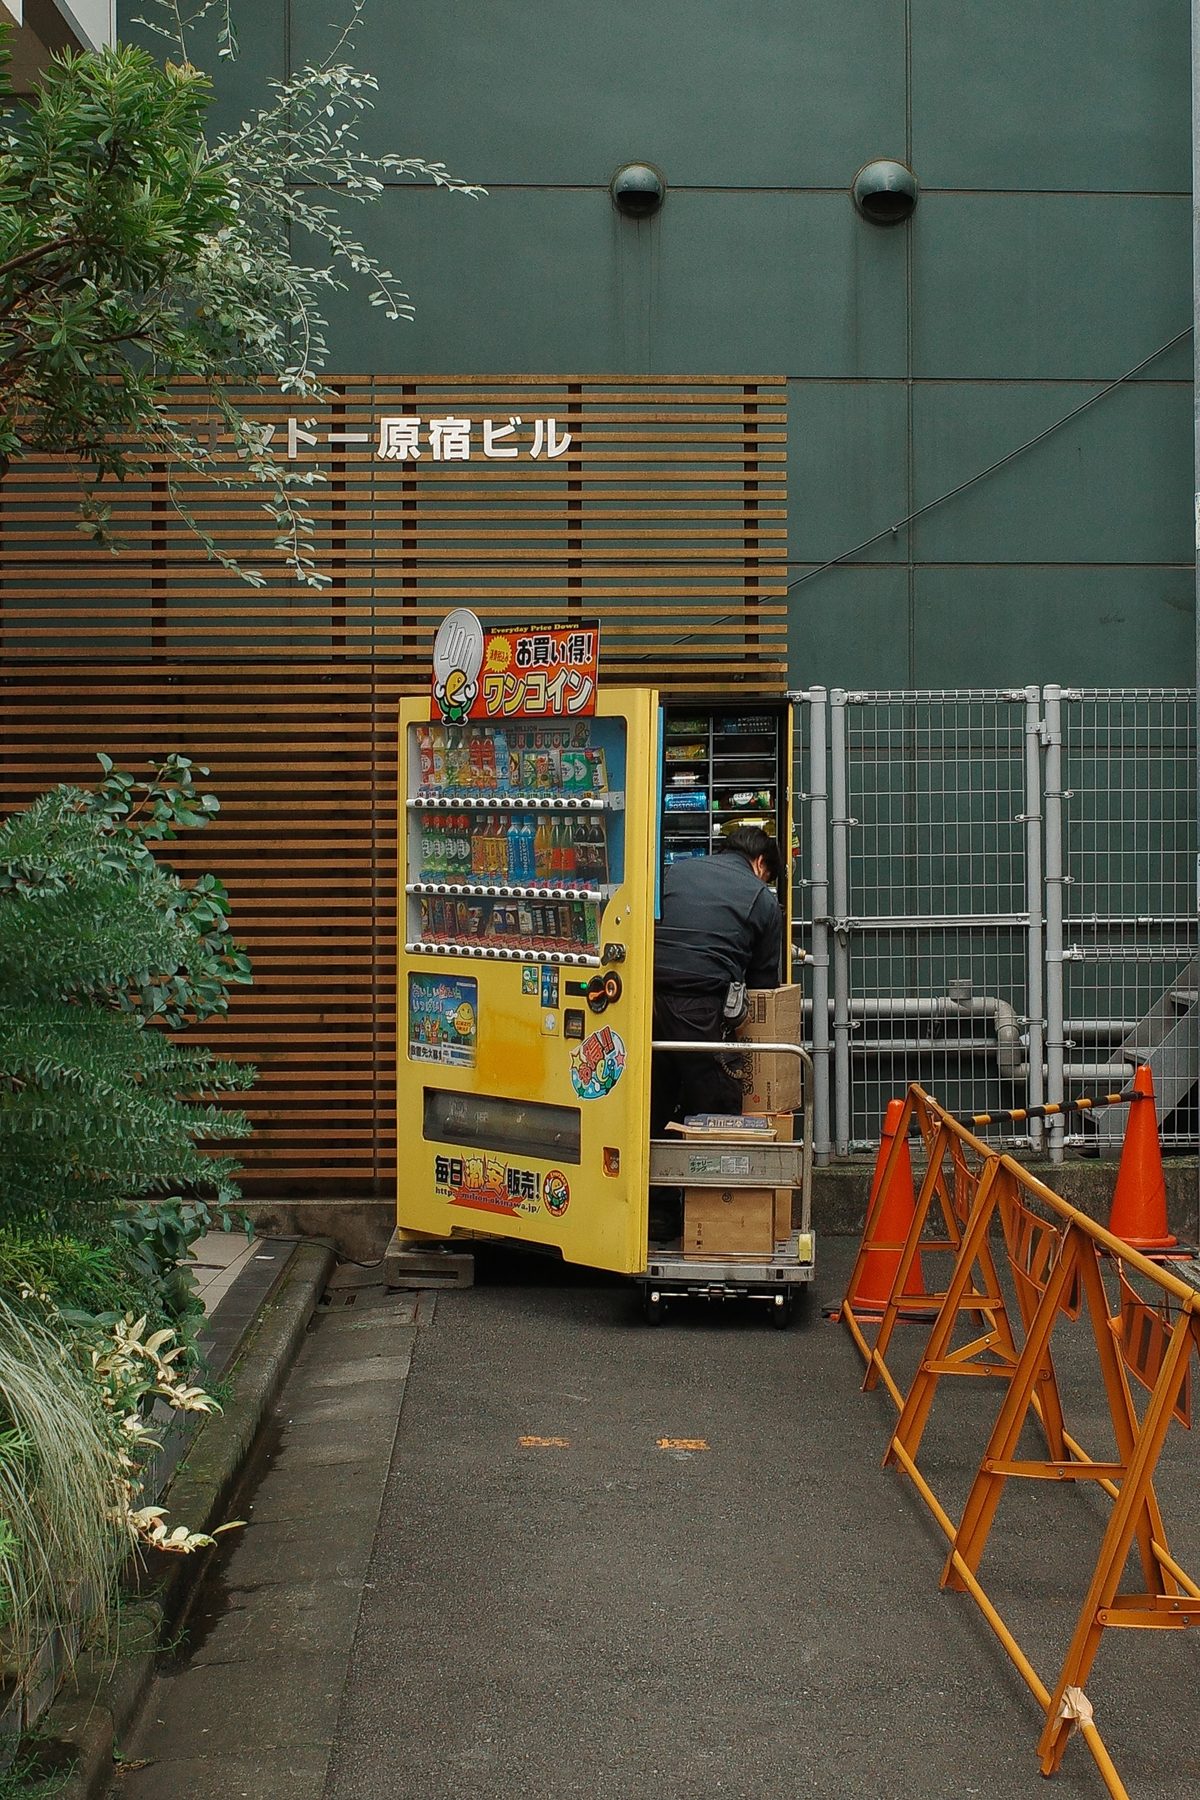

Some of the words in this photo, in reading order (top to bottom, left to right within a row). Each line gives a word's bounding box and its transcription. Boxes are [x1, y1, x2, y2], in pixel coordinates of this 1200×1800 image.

[491, 626, 529, 634] Everyday
[516, 634, 592, 666] お買い得!
[485, 668, 593, 714] ワンコイン
